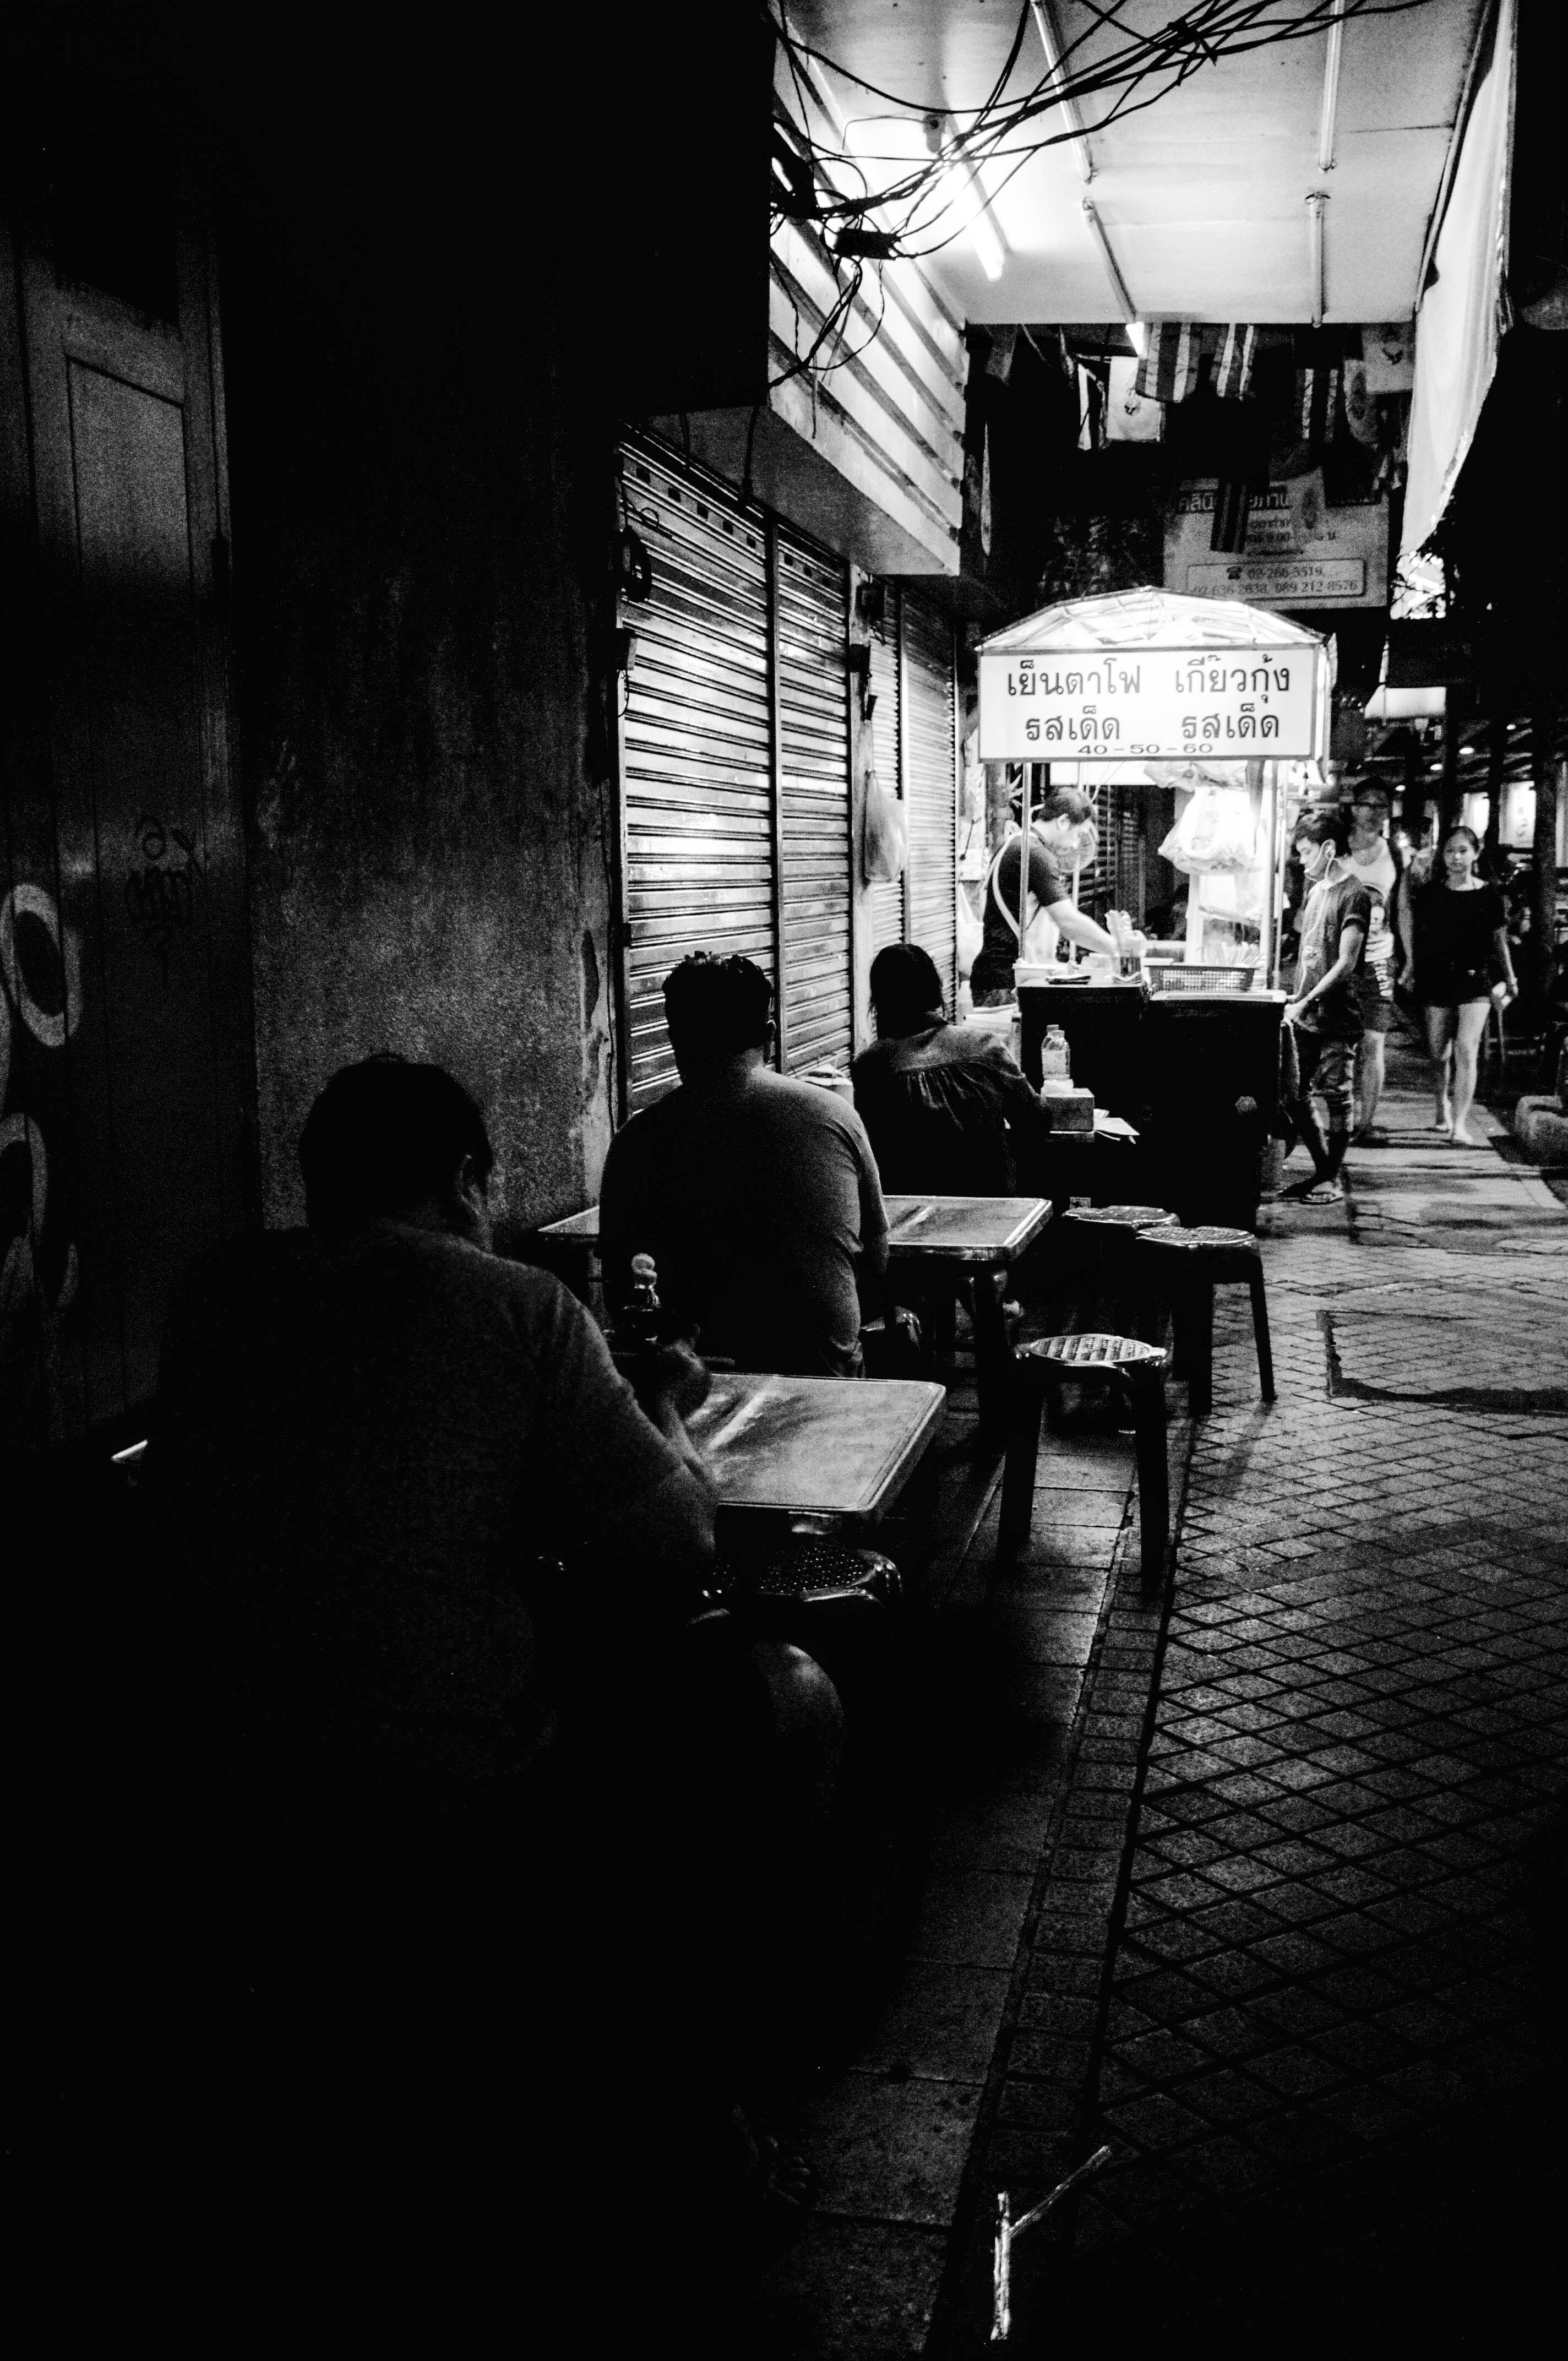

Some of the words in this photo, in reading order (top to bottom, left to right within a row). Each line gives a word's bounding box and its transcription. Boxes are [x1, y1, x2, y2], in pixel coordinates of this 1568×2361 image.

[1008, 658, 1140, 695] เย็นตาโฟ
[1176, 654, 1289, 703] เกี๊ยวกุ้ง
[1026, 705, 1119, 740] รสเด็ด
[1182, 703, 1279, 738] รสเด็ด
